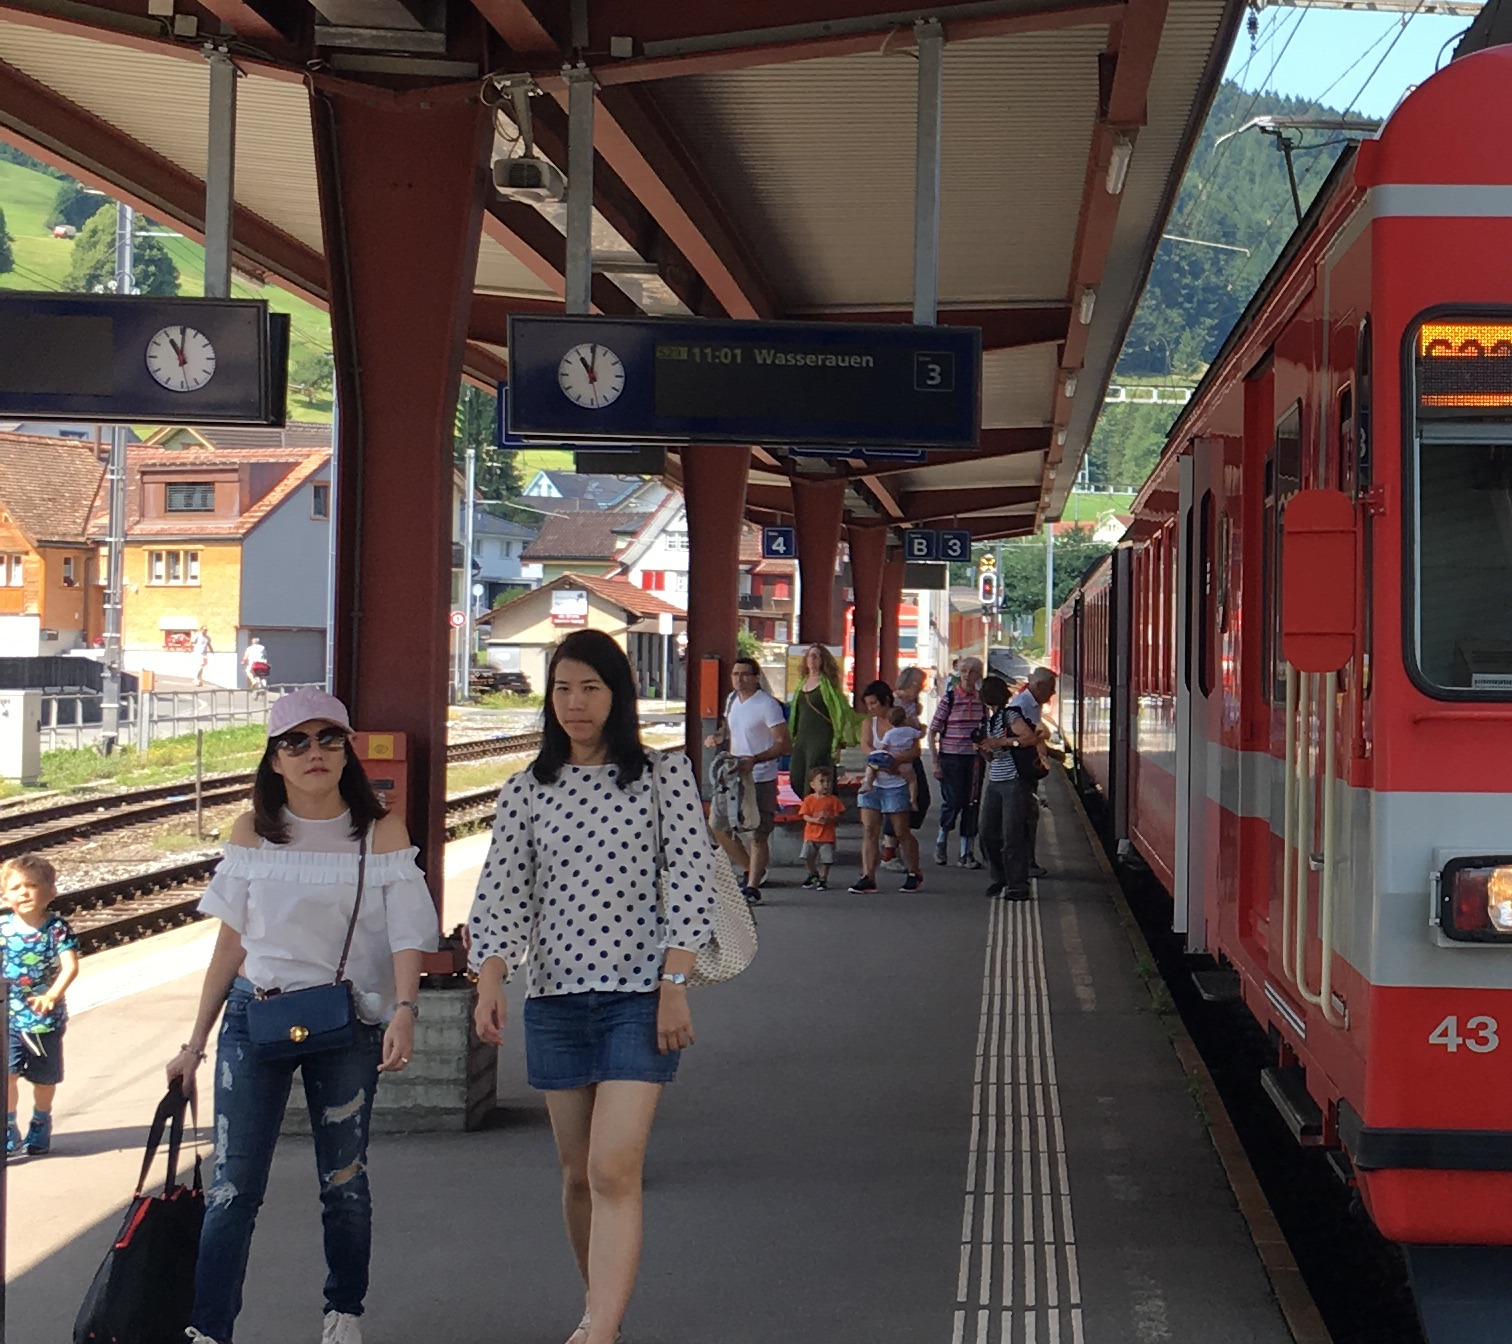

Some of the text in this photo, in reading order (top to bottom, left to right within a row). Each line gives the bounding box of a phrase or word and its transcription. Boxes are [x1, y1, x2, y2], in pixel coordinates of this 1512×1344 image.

[692, 348, 742, 364] 11:01
[754, 349, 874, 368] Wasserauen
[926, 364, 941, 385] 3
[772, 537, 787, 554] 4
[914, 539, 928, 556] B
[947, 539, 961, 556] 3
[1428, 1015, 1500, 1053] 43
